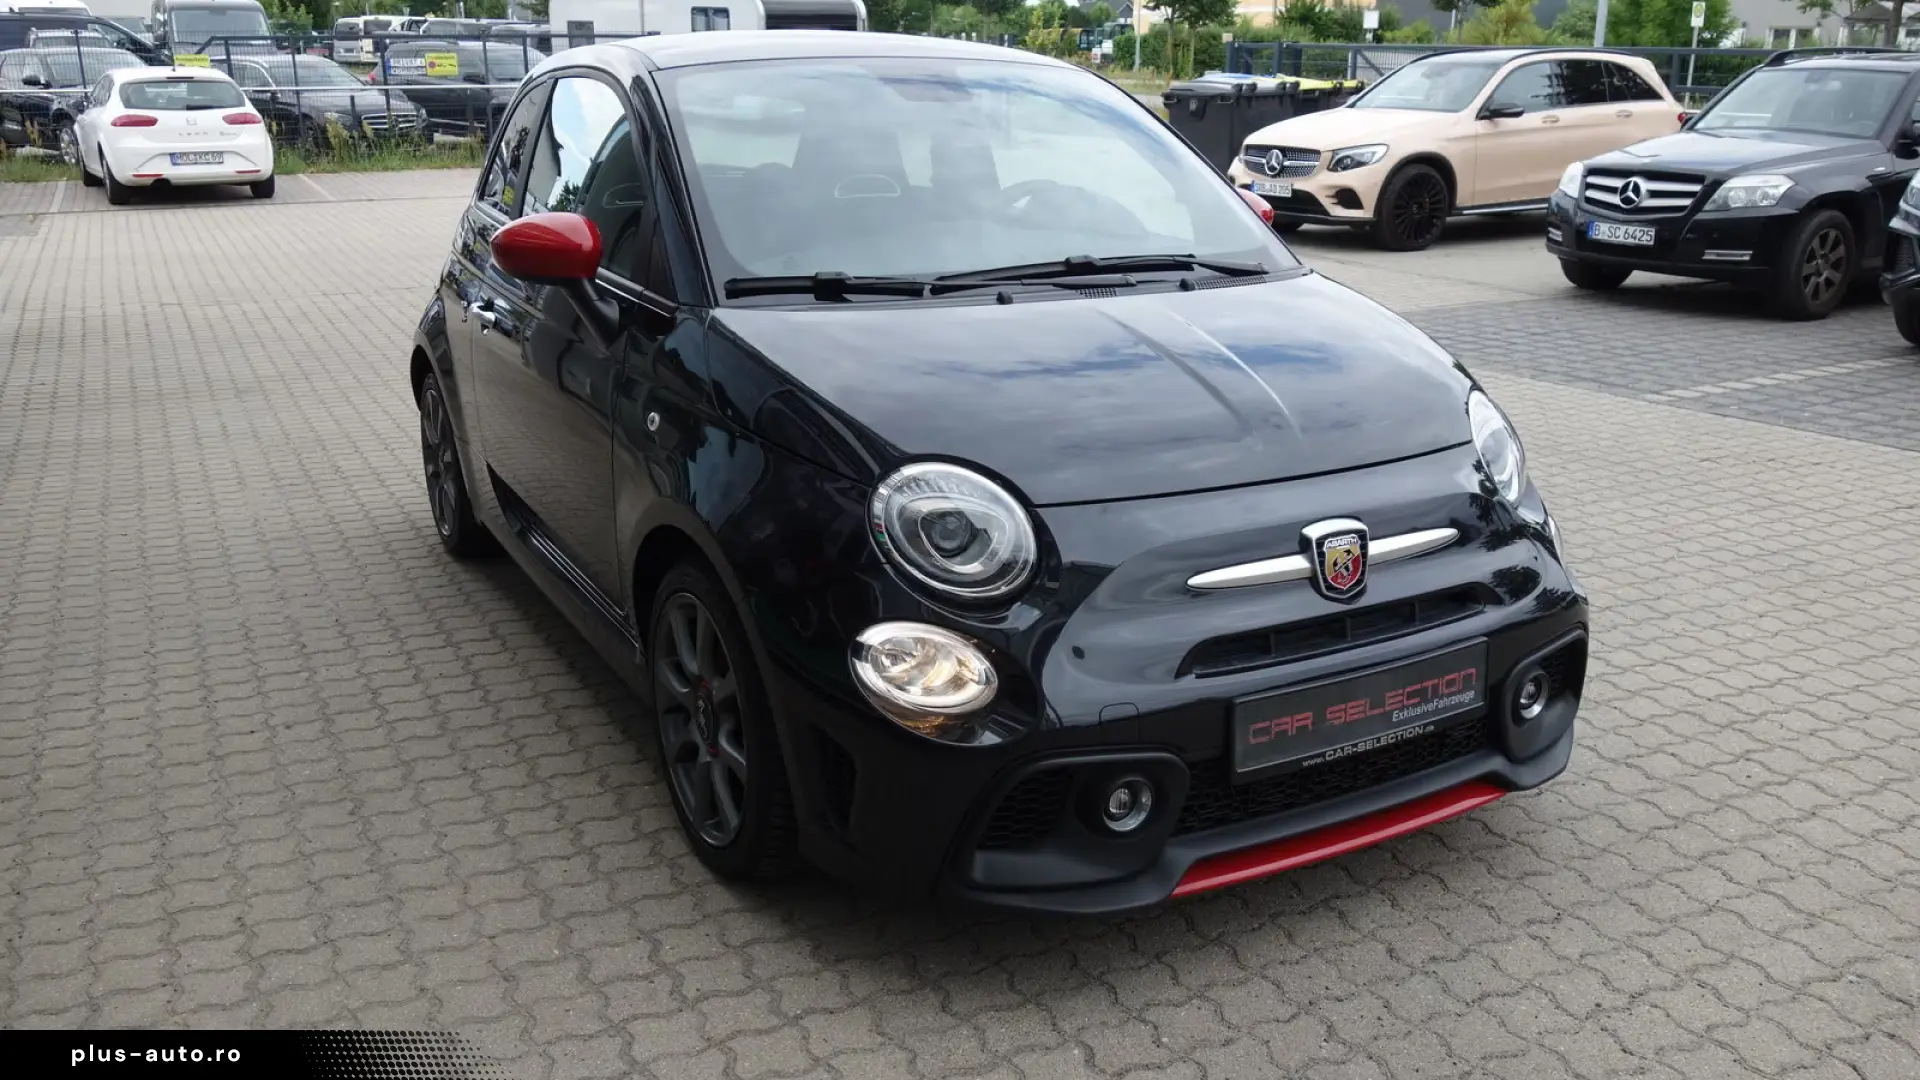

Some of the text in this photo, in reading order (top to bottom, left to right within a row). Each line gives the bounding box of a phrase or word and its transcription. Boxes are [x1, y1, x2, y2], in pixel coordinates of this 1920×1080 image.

[1594, 224, 1653, 242] B SC 6425
[1248, 711, 1314, 745] CAR
